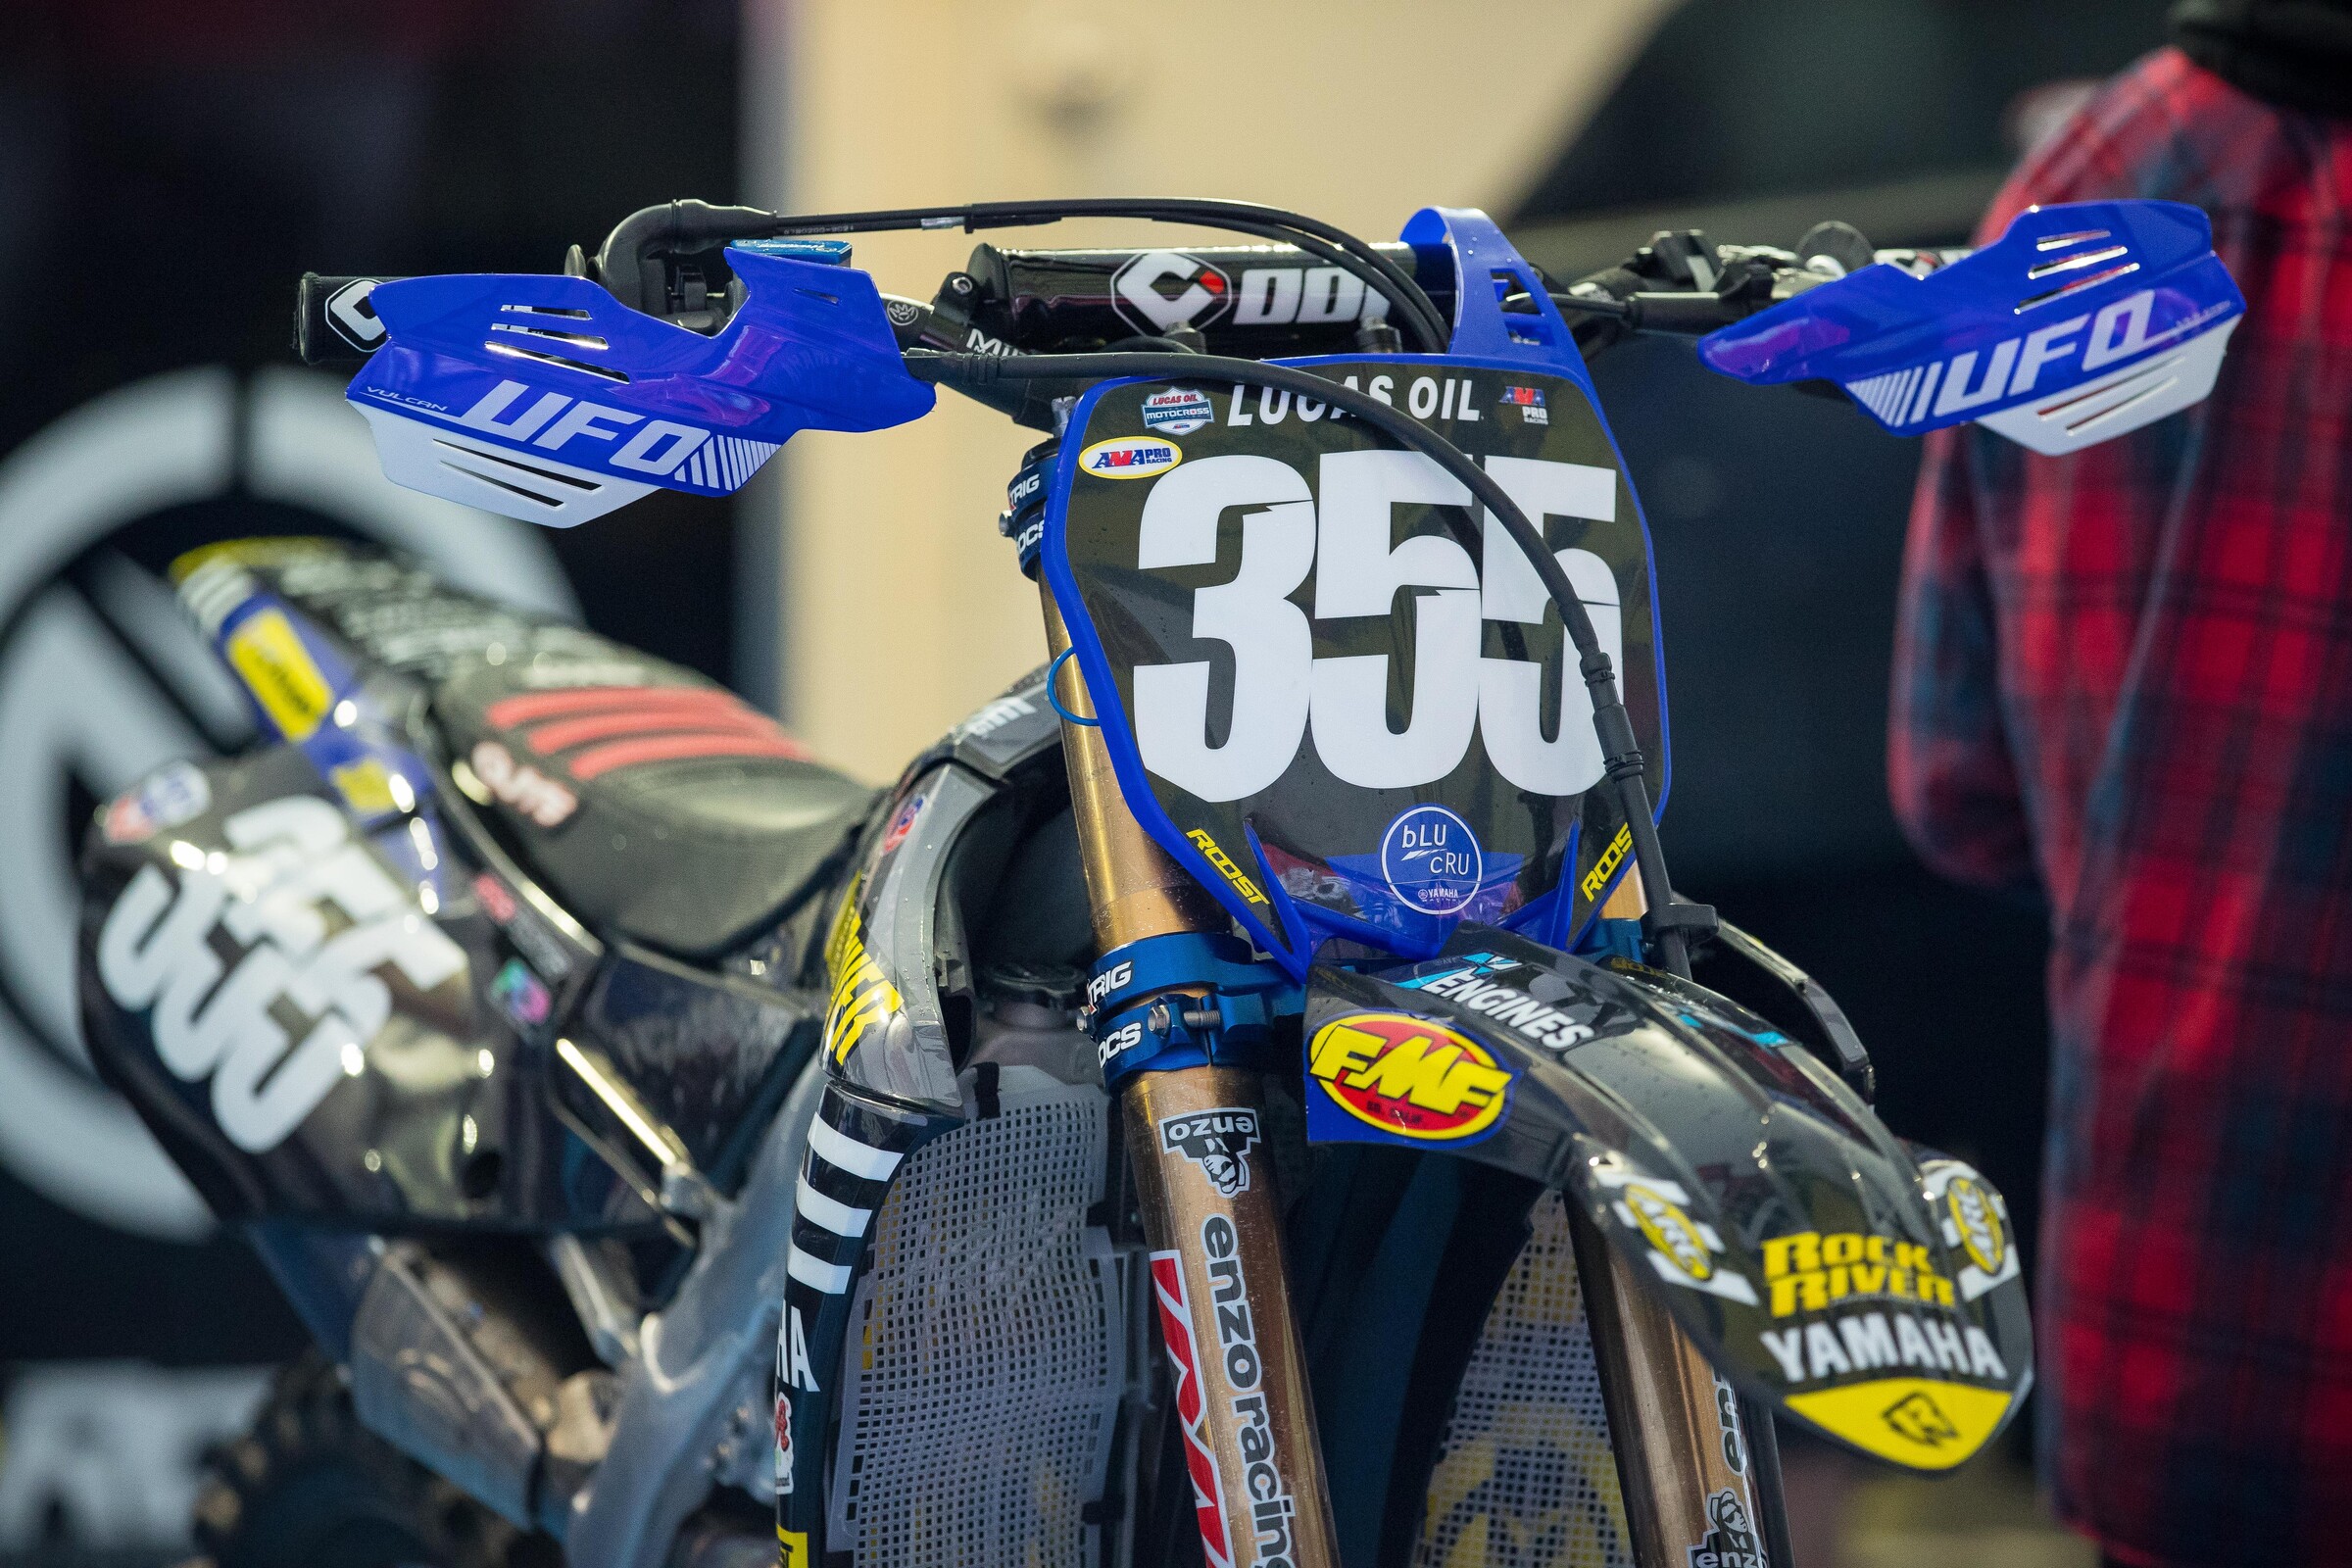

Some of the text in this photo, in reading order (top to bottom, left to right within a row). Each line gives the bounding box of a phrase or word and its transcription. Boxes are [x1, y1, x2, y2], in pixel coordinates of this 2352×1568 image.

[1934, 290, 2155, 416] UFO
[366, 386, 448, 412] VULCAN
[1146, 407, 1210, 419] MOTOCROSS
[1152, 394, 1199, 406] LUCAS OIL
[1408, 375, 1481, 421] OIL
[1498, 386, 1545, 406] AMA
[1522, 406, 1548, 417] PRO
[460, 378, 711, 476] UFO
[1092, 447, 1172, 469] AMA PRO
[1133, 449, 1623, 801] 355
[1186, 828, 1269, 906] ROOST
[1581, 821, 1634, 903] ROOS
[1428, 888, 1459, 899] YAMAHA
[100, 797, 467, 1153] 355
[1420, 966, 1595, 1049] ENGINES
[1309, 1023, 1513, 1115] FMF
[1168, 1116, 1255, 1141] enzo
[1761, 1231, 1934, 1277] ROCK
[1769, 1264, 1955, 1318] RIVER
[1760, 1312, 2008, 1383] YAMAHA
[1234, 1396, 1292, 1568] racin
